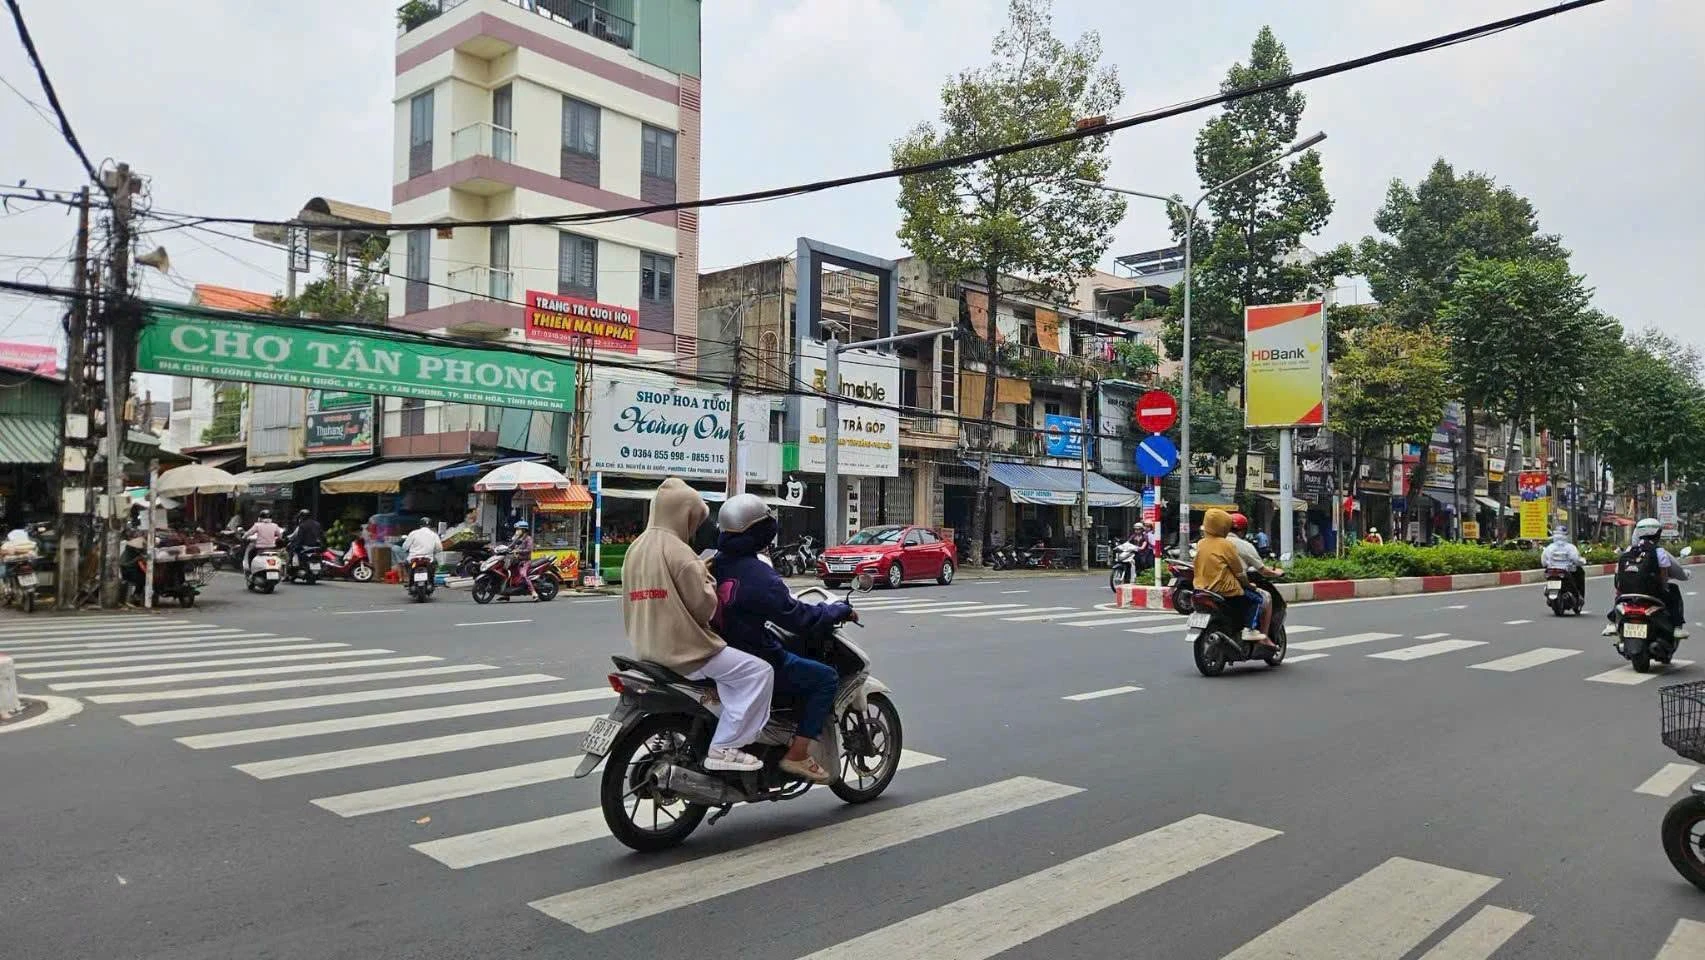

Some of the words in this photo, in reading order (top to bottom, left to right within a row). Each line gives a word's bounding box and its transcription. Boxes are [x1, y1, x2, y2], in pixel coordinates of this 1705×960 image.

[536, 297, 570, 312] TRANG
[574, 318, 604, 337] NAM
[170, 325, 293, 371] CHỢ
[306, 340, 403, 375] TÂN
[416, 354, 557, 393] PHONG
[1251, 348, 1305, 361] HDBank
[636, 391, 671, 405] SHOP
[673, 396, 699, 409] HOA
[613, 406, 689, 447] Hoàng
[843, 417, 862, 432] TRẢ
[632, 448, 652, 459] 0364
[654, 450, 669, 460] 855
[671, 451, 685, 461] 998
[712, 453, 725, 464] 115
